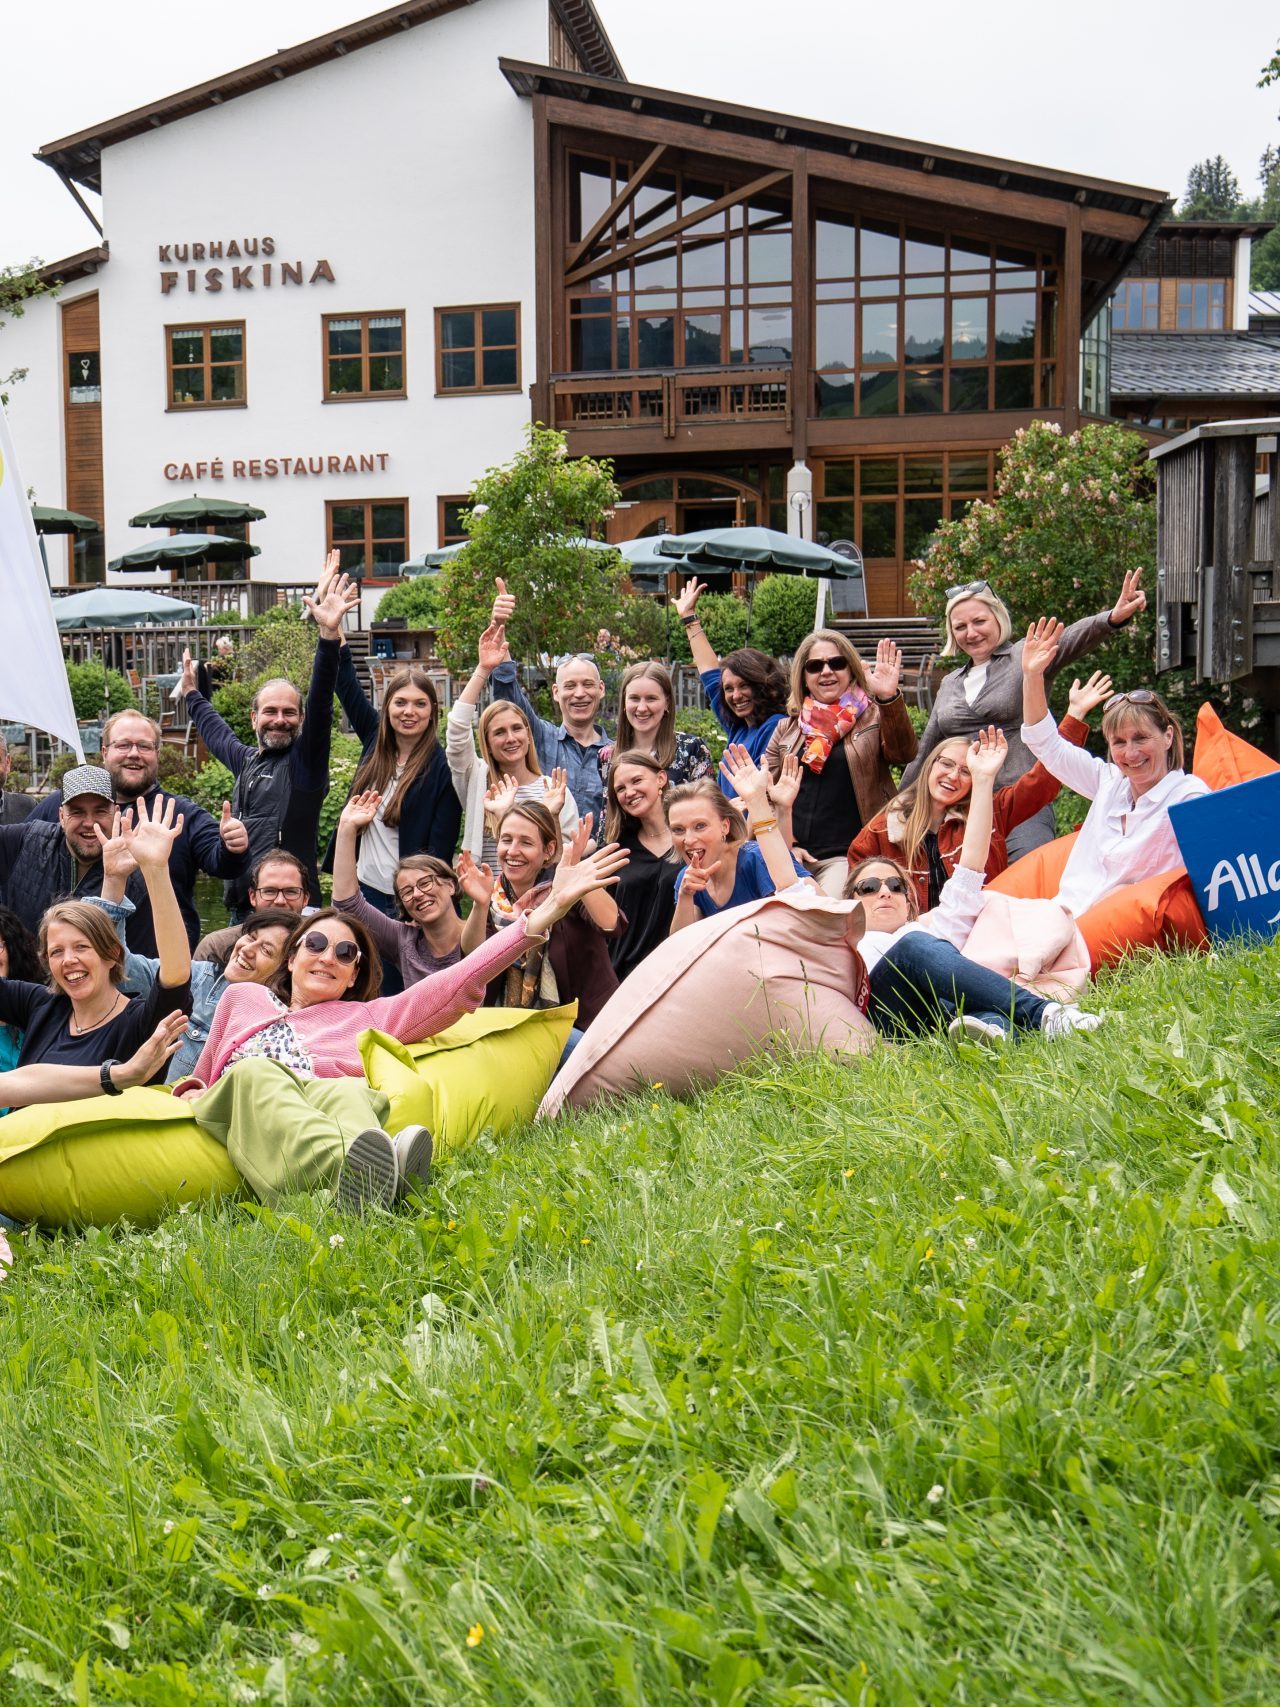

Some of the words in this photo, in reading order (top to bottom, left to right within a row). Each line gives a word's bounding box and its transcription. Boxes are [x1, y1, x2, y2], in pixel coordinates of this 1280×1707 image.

[158, 236, 276, 263] KURHAUS
[160, 259, 336, 294] FISKINA
[163, 457, 225, 481] CAFÉ
[232, 453, 390, 478] RESTAURANT
